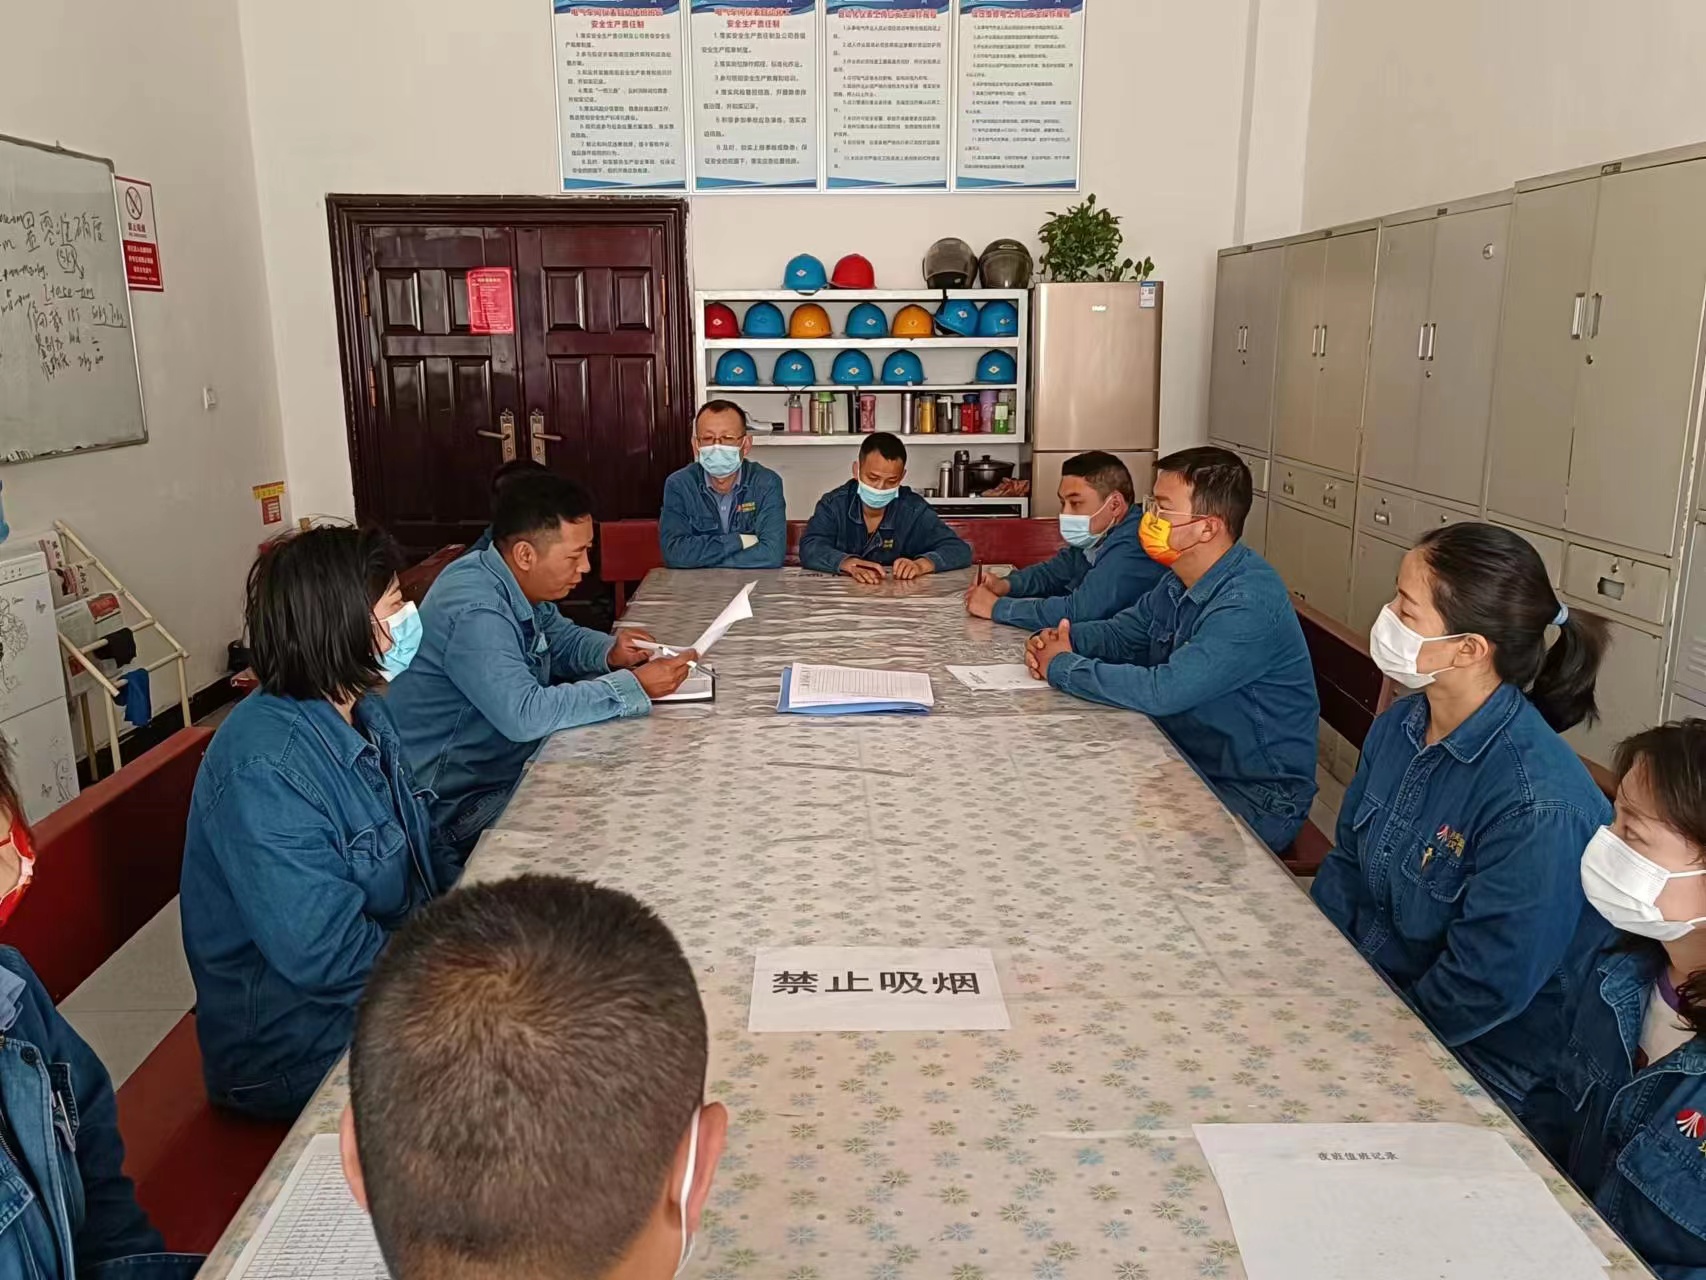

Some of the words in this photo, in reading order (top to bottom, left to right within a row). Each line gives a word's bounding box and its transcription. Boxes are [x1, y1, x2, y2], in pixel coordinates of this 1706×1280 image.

[591, 20, 645, 29] 安全生产责任制
[727, 20, 780, 29] 安全生产责任制
[771, 970, 981, 994] 禁止吸烟
[1317, 1151, 1399, 1161] 夜班值班记录
